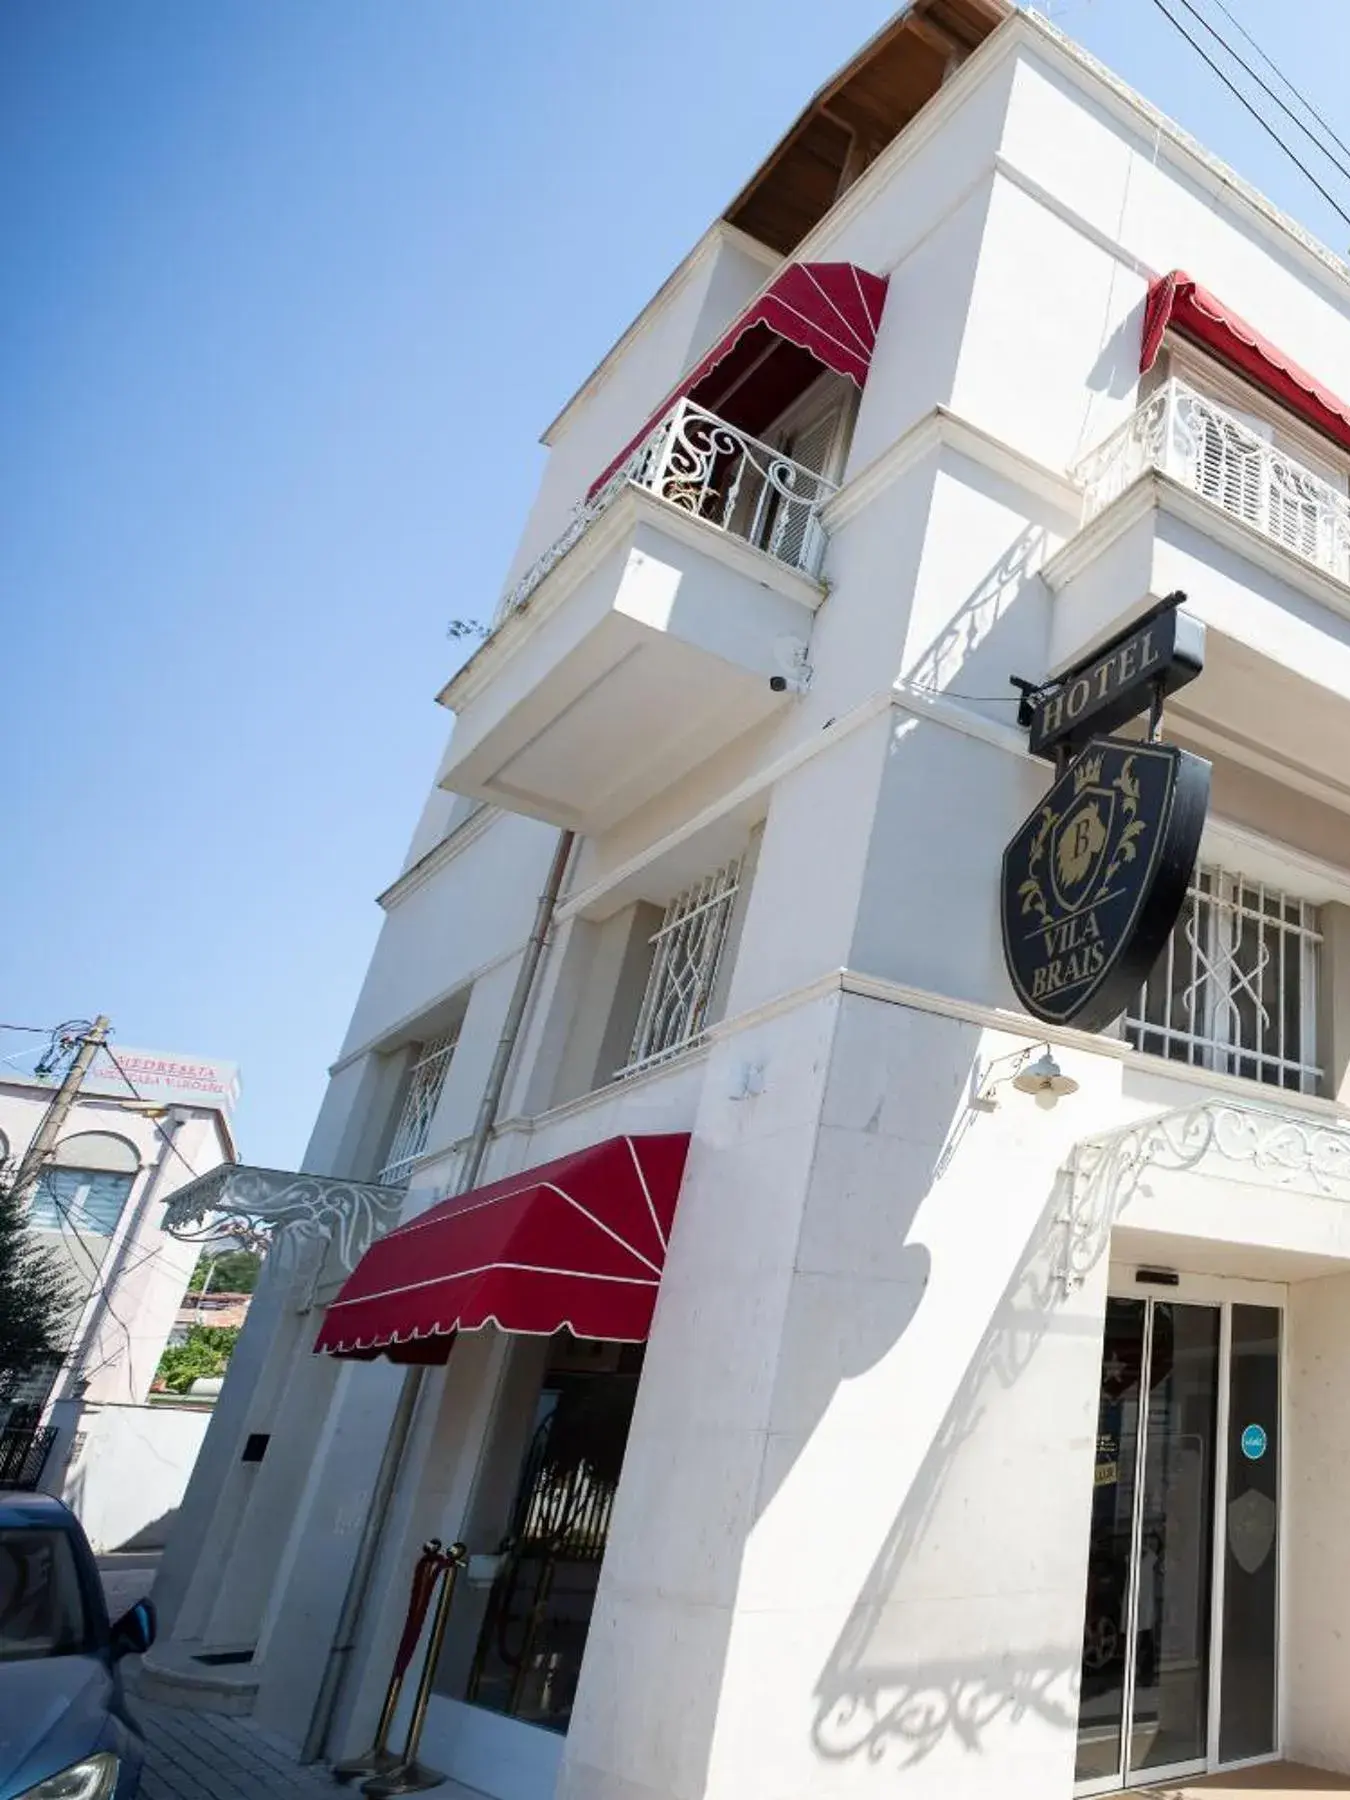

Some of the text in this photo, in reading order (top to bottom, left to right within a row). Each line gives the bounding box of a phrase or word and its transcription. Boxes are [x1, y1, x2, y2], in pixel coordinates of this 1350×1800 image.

[1041, 631, 1158, 738] HOTEL
[1073, 818, 1091, 860] B
[1044, 910, 1100, 958] VILA
[1031, 939, 1105, 999] BRAIS
